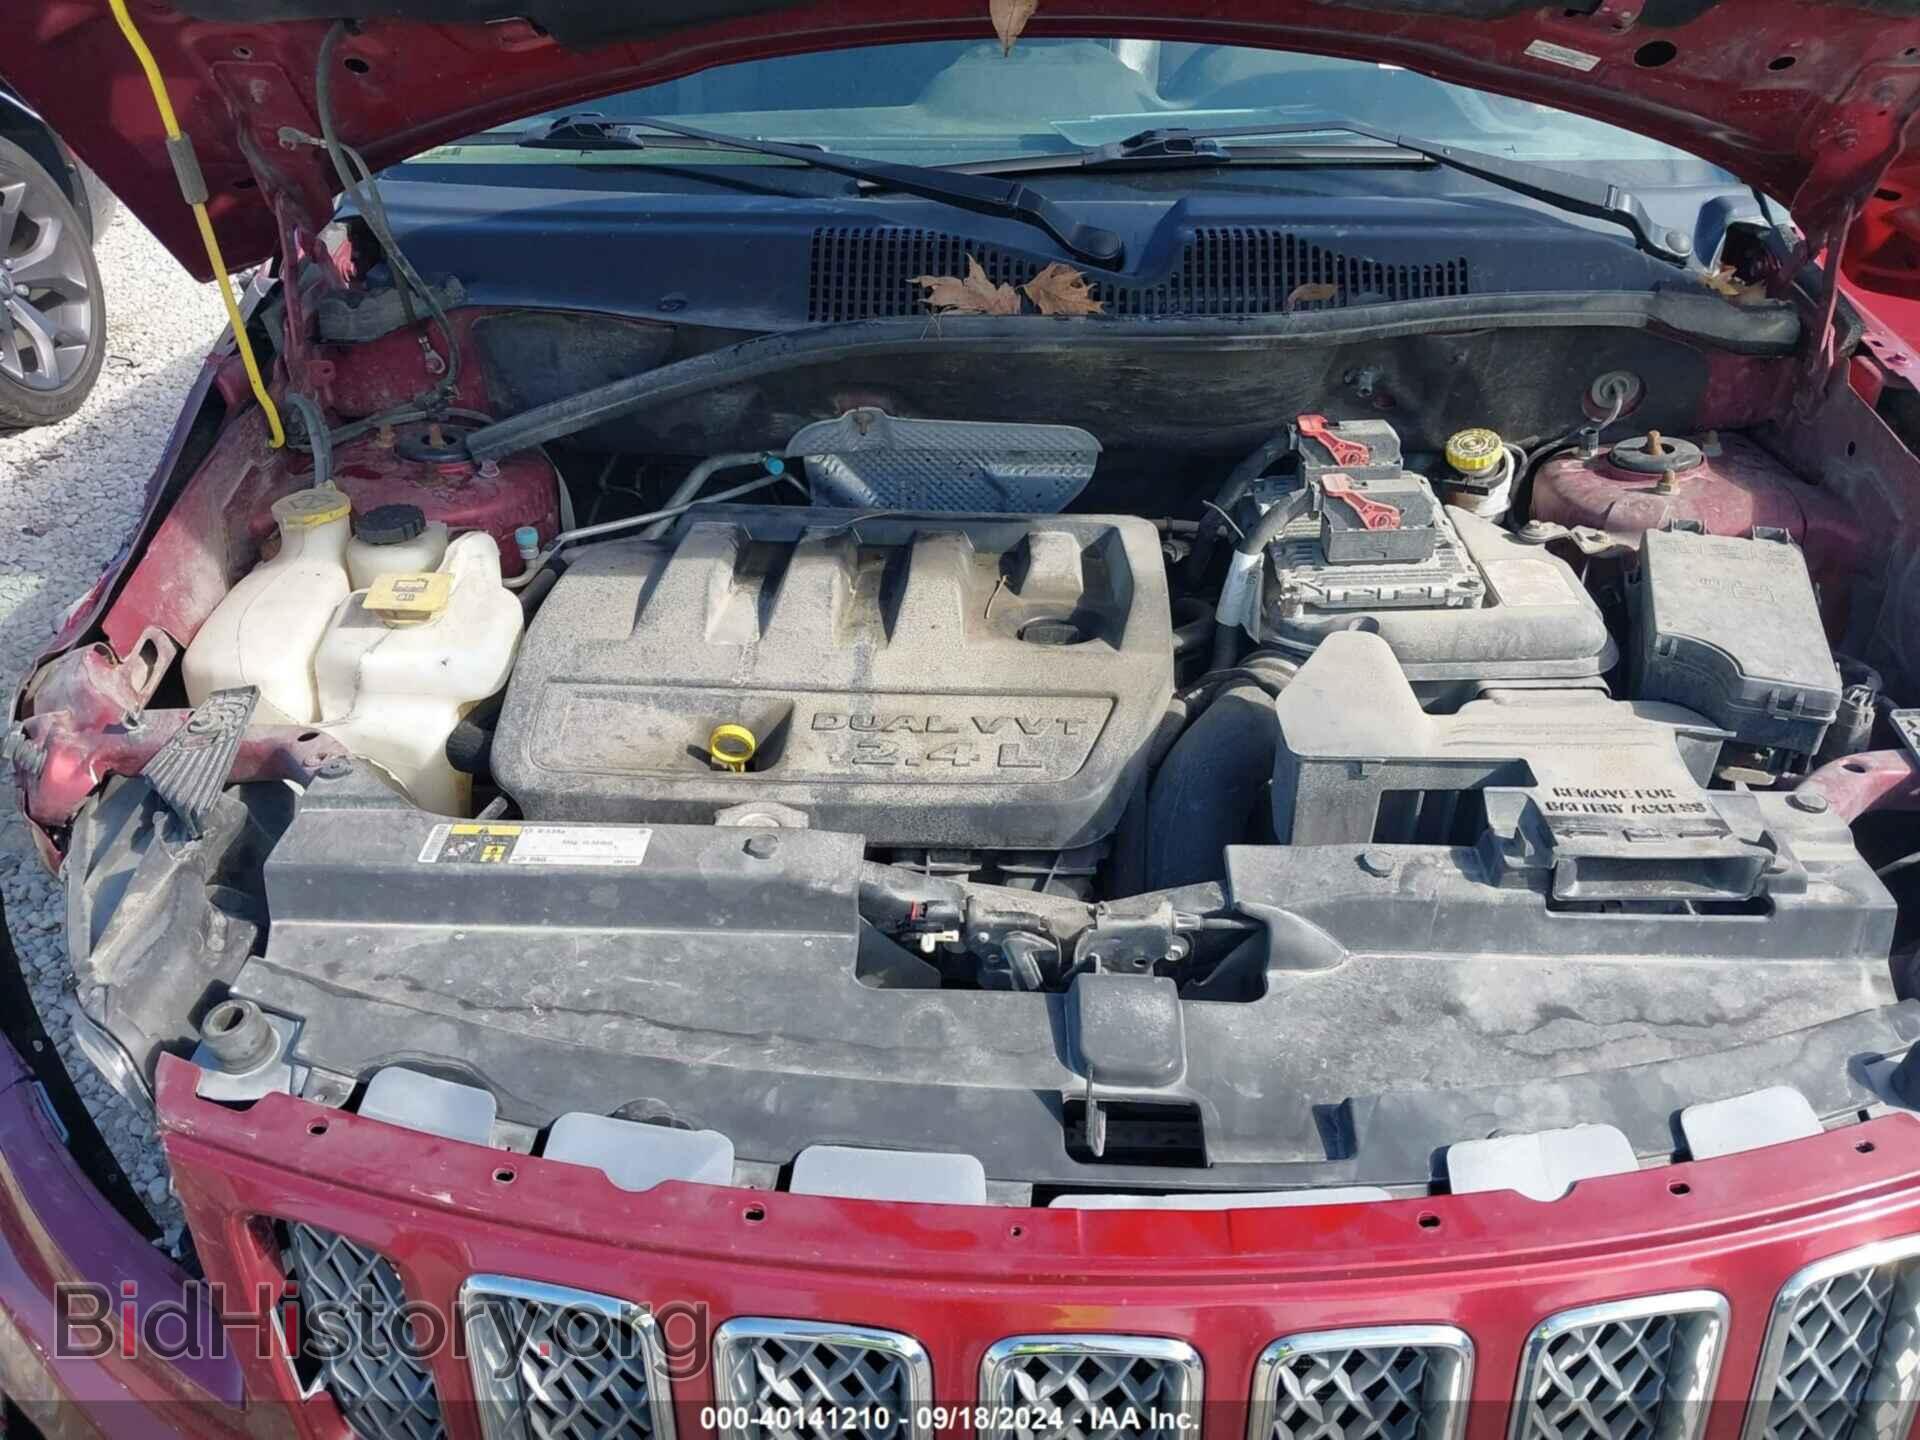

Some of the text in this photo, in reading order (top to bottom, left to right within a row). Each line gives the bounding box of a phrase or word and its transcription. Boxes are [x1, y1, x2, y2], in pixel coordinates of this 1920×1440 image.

[811, 713, 1087, 736] DUAL VVT
[1552, 786, 1677, 800] REMOVE FOR
[1545, 801, 1708, 815] BATTERY ACCESS
